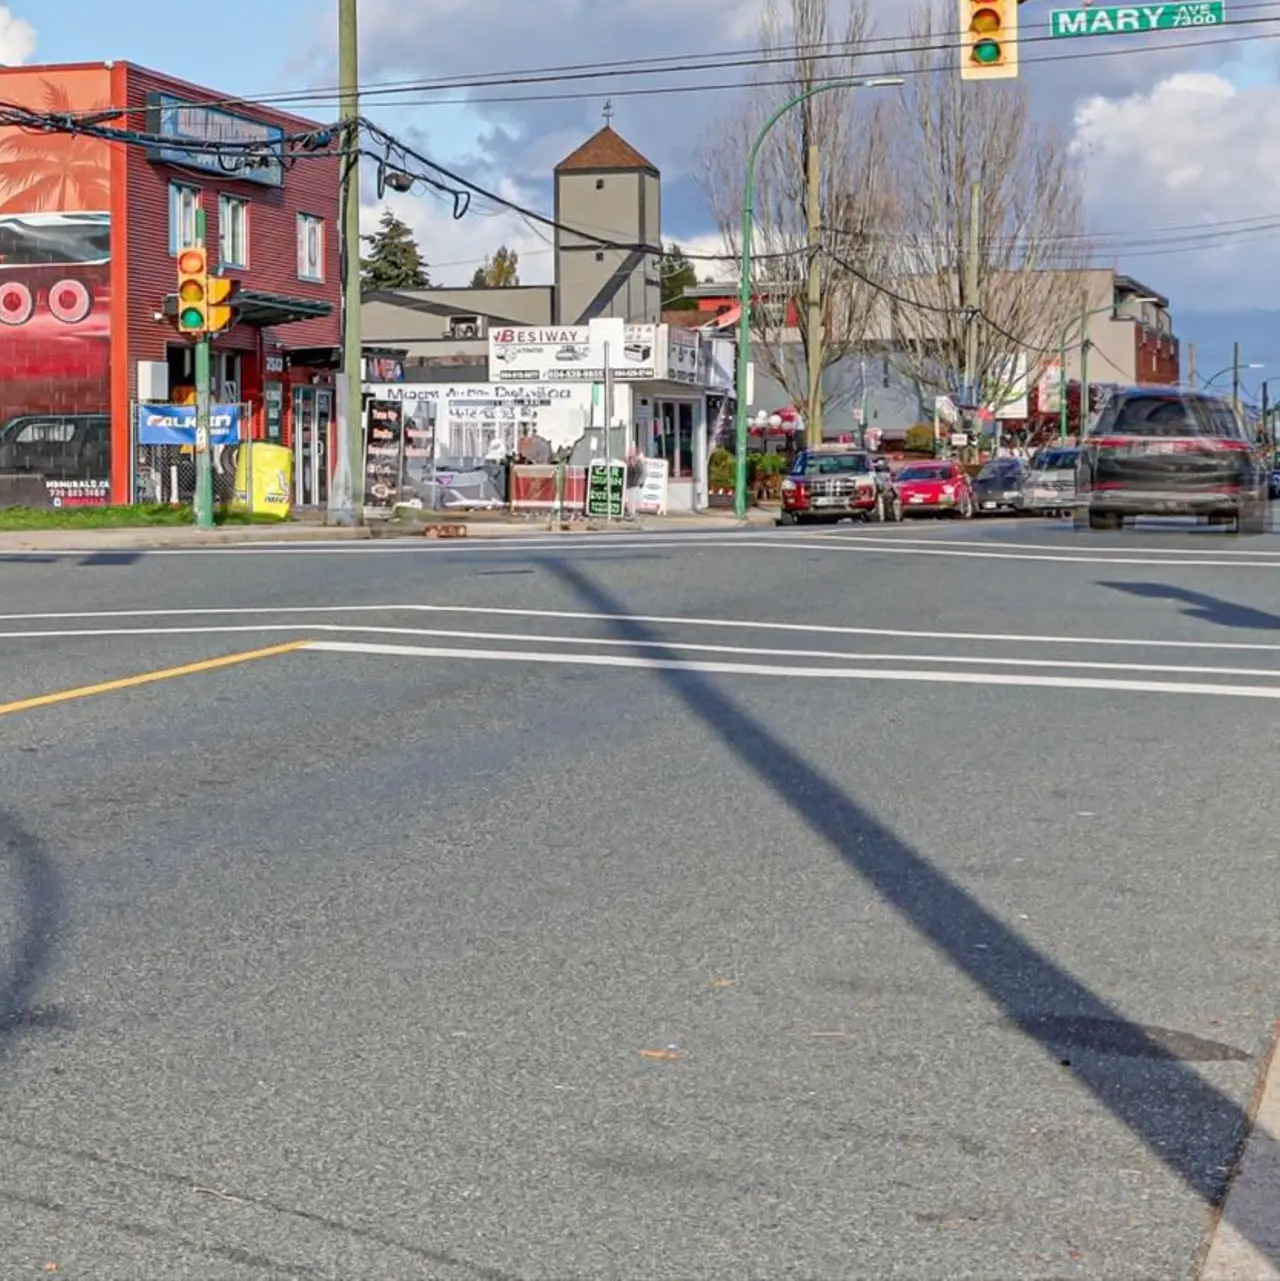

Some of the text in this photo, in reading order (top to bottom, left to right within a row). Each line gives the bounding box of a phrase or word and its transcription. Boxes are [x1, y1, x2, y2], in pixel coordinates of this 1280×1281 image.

[1177, 4, 1211, 16] AVE
[1058, 7, 1165, 33] MARY
[1171, 13, 1217, 27] 7300
[146, 413, 232, 428] FALKN
